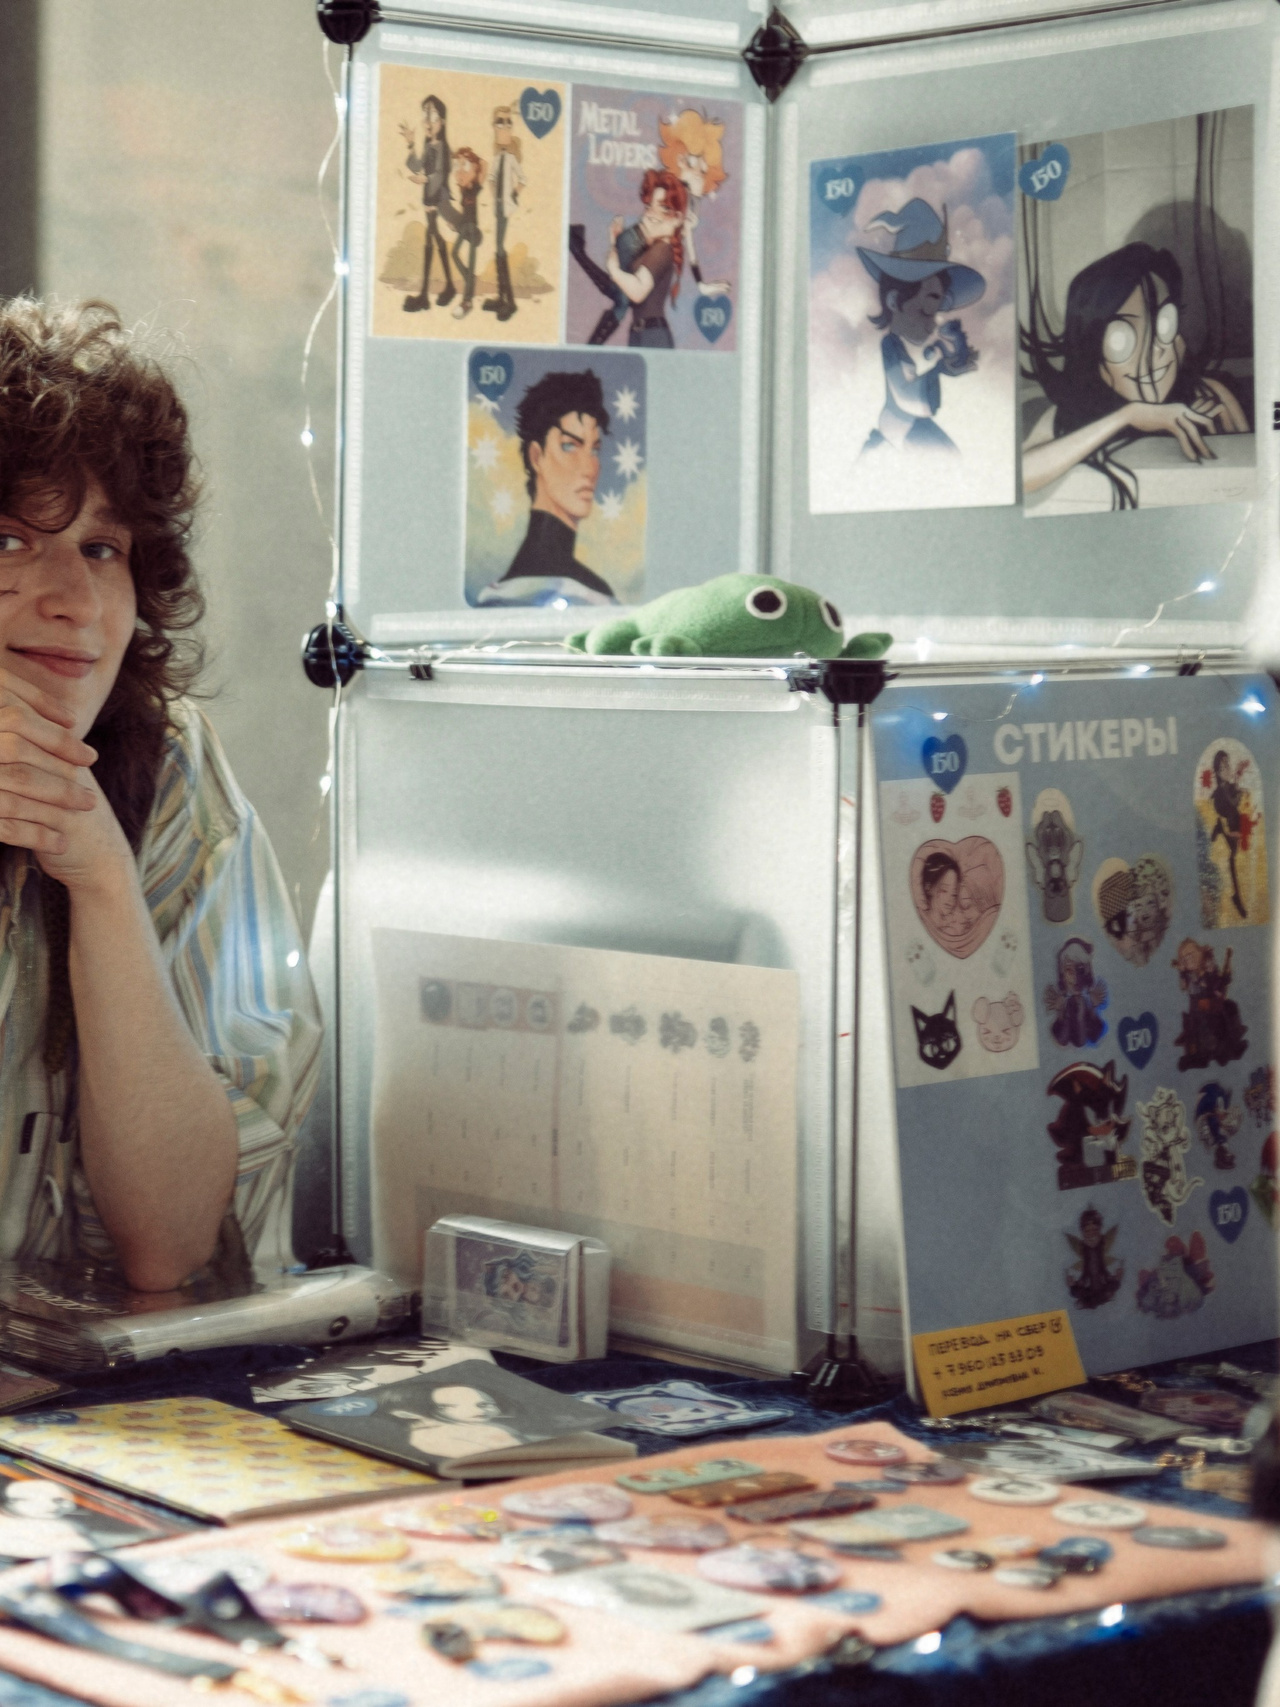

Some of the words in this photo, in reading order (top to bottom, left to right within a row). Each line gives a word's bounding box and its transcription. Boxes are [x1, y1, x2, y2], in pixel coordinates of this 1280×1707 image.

[527, 102, 553, 123] 150
[588, 132, 658, 171] LOVERS
[825, 176, 854, 199] 150
[1030, 160, 1062, 193] 150
[700, 307, 725, 328] 150
[479, 364, 506, 386] 150
[993, 716, 1179, 766] СТИКЕРЫ
[931, 751, 959, 774] 150
[1125, 1028, 1151, 1052] 150
[1217, 1202, 1242, 1225] 150
[928, 1334, 990, 1355] ПЕРЕВОД
